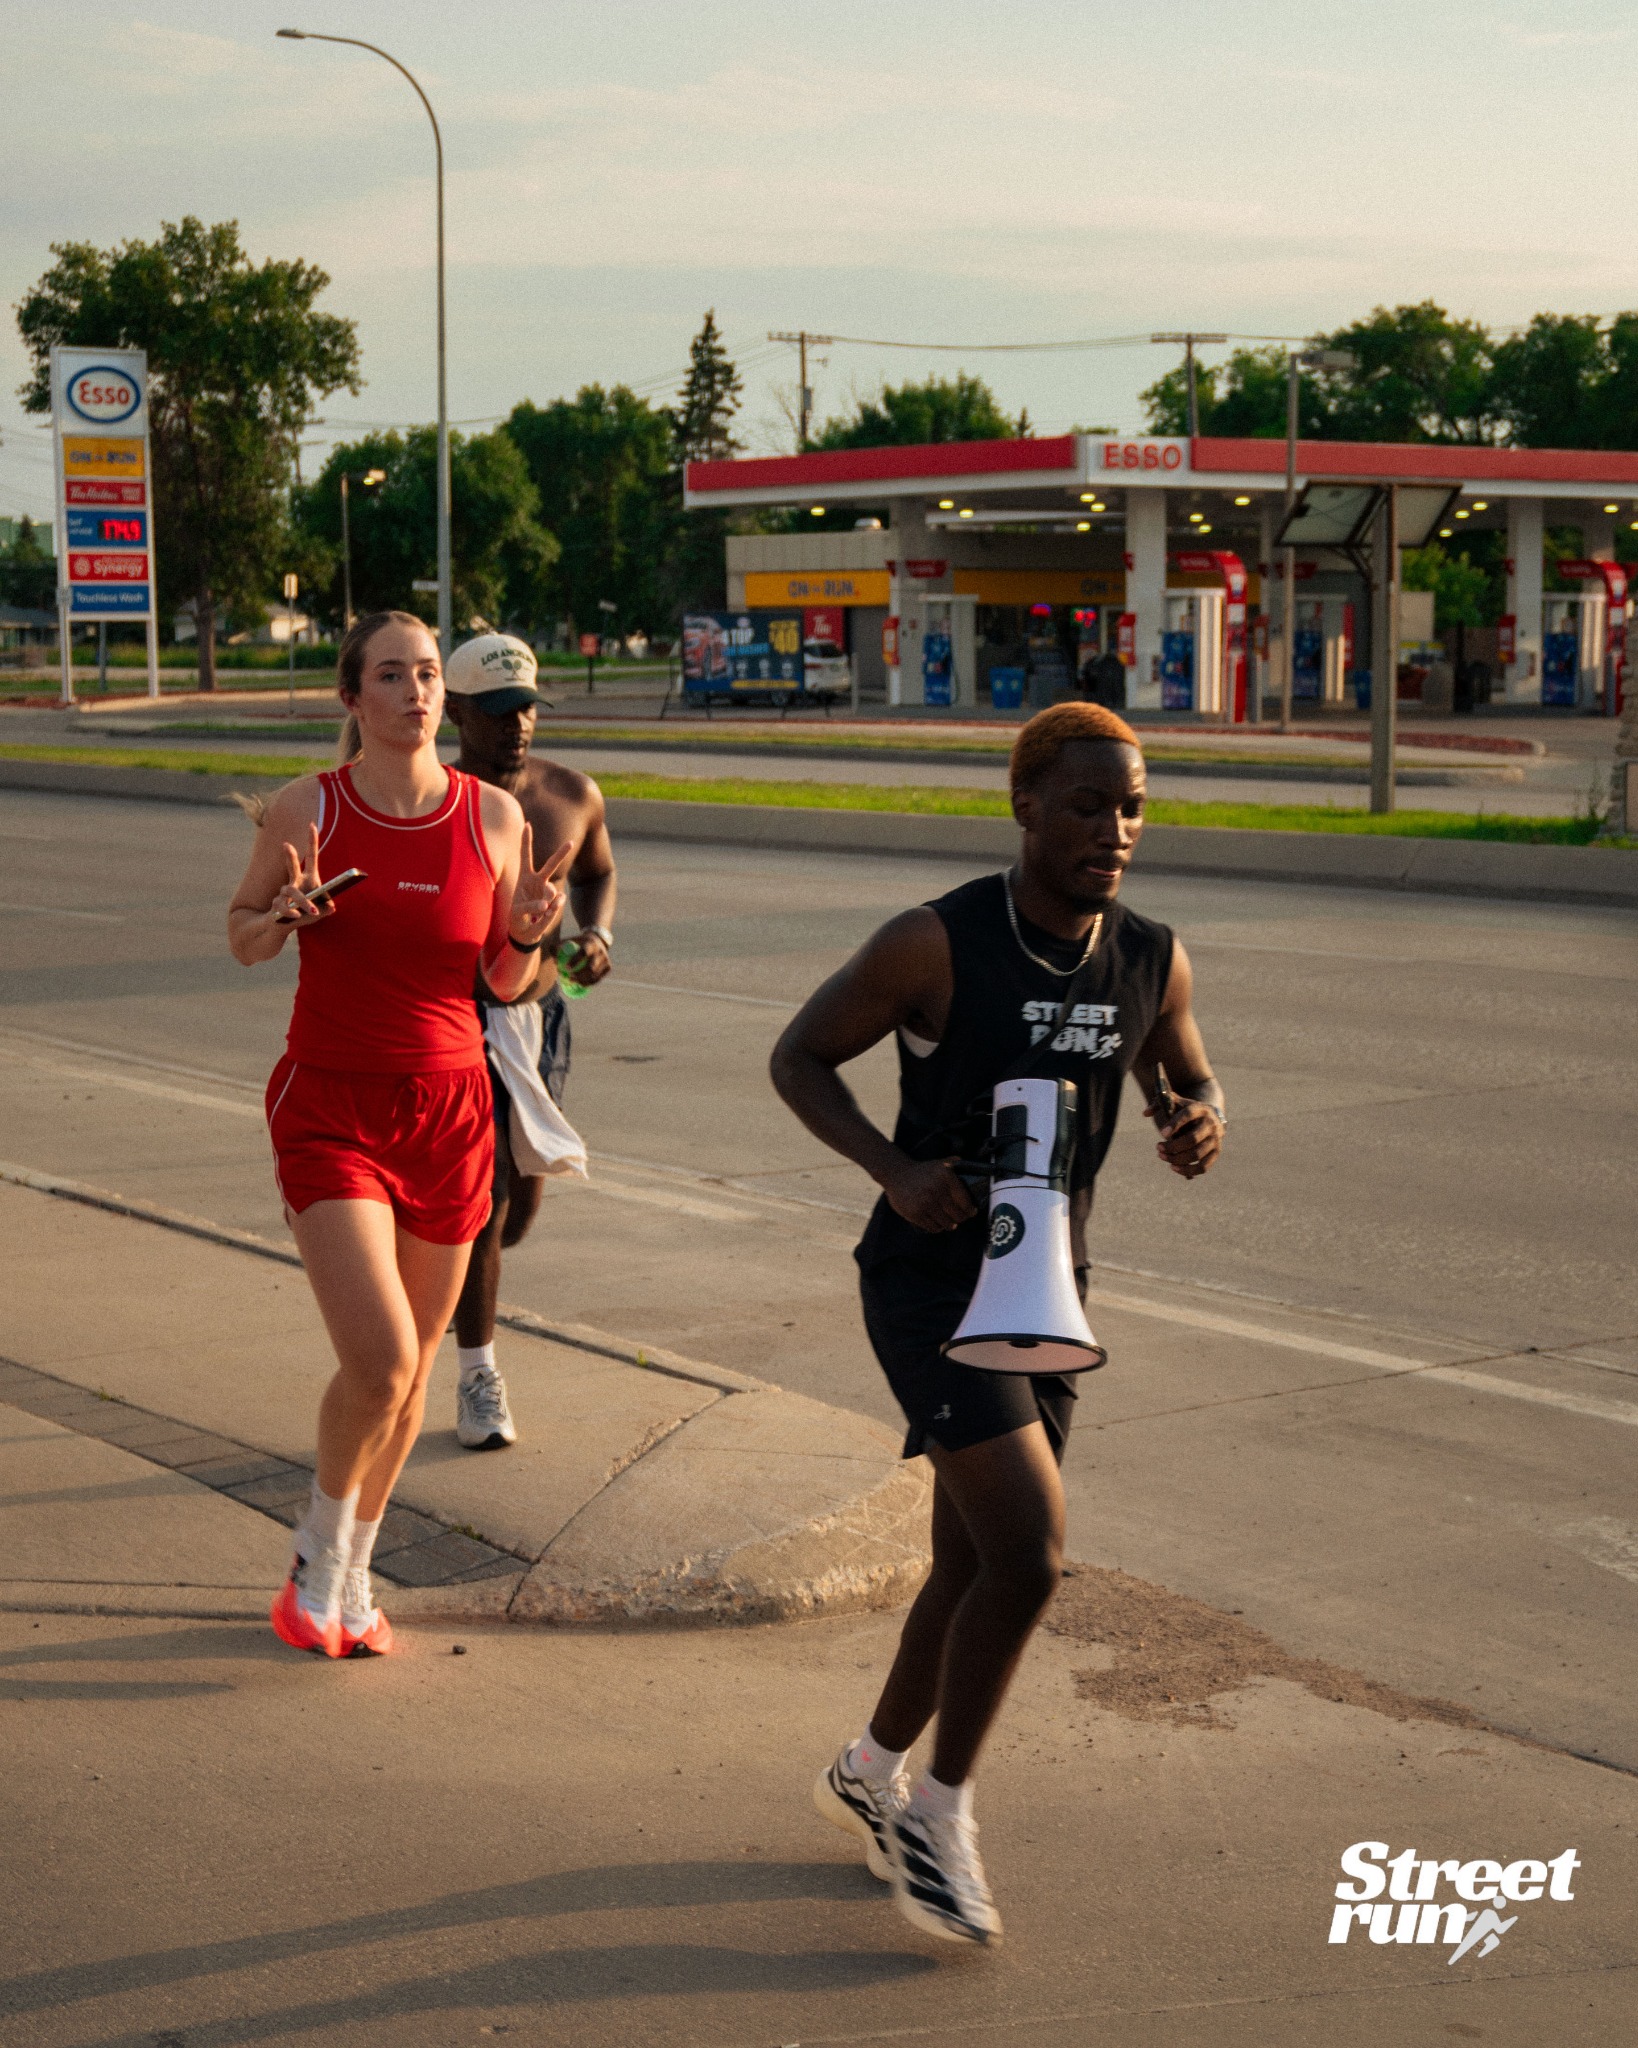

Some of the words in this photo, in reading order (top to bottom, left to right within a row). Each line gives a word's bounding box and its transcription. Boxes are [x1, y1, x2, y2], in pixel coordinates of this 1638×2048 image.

[80, 381, 130, 405] Esso
[1104, 442, 1182, 471] ESSO
[93, 559, 144, 577] Synergy
[76, 591, 118, 603] Touchless
[120, 592, 143, 603] Wash
[789, 580, 809, 597] ON
[481, 650, 499, 666] LOS
[397, 881, 440, 894] SPYDER
